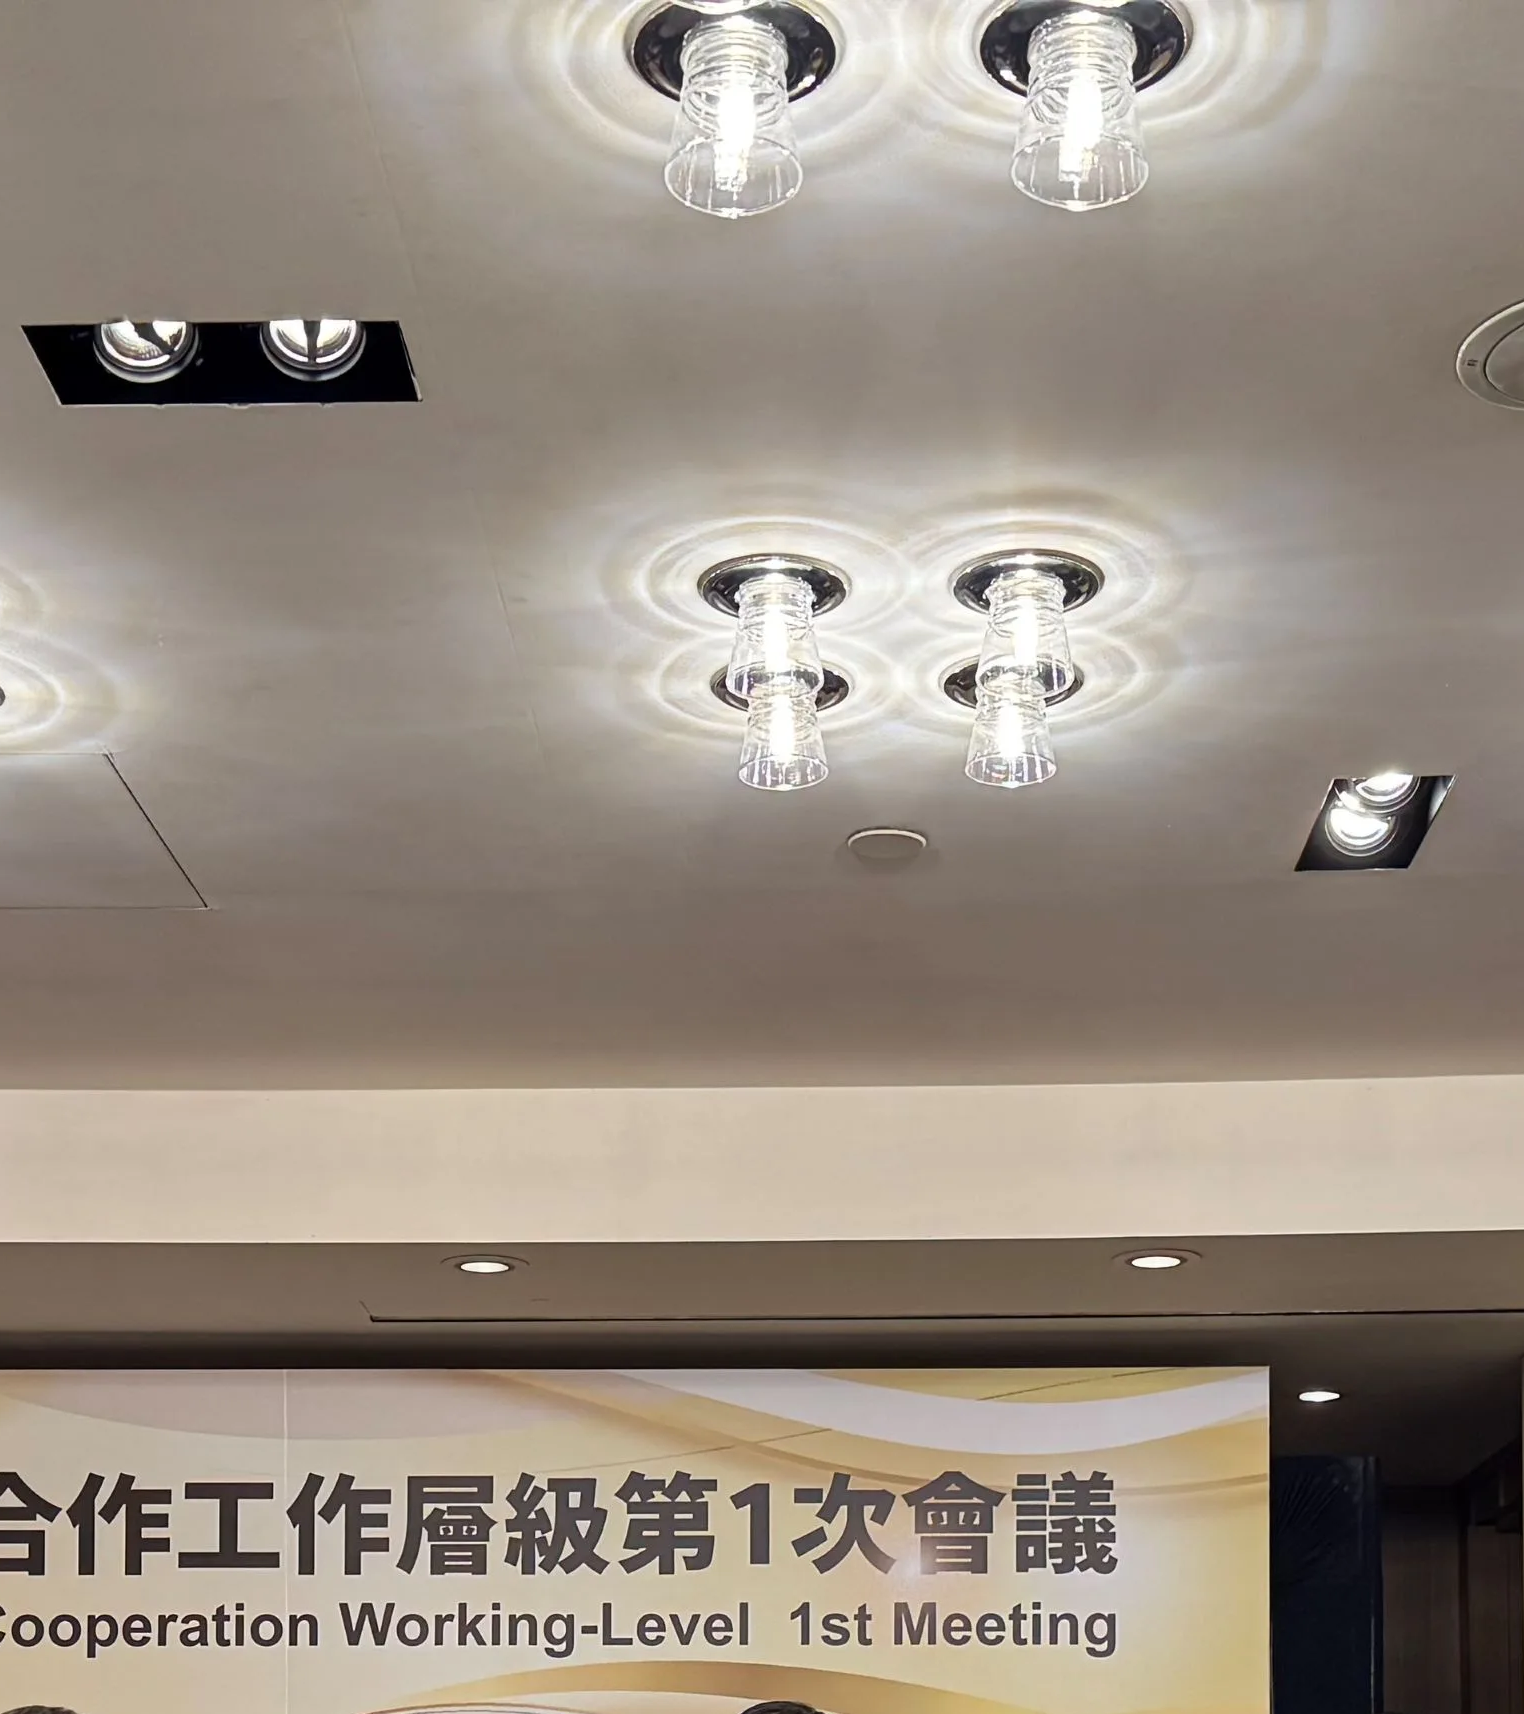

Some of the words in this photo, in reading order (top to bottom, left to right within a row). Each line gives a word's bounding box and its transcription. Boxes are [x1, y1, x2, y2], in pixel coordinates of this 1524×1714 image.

[338, 1601, 750, 1659] Working-Level
[789, 1601, 873, 1647] 1st
[893, 1601, 1117, 1658] Meeting
